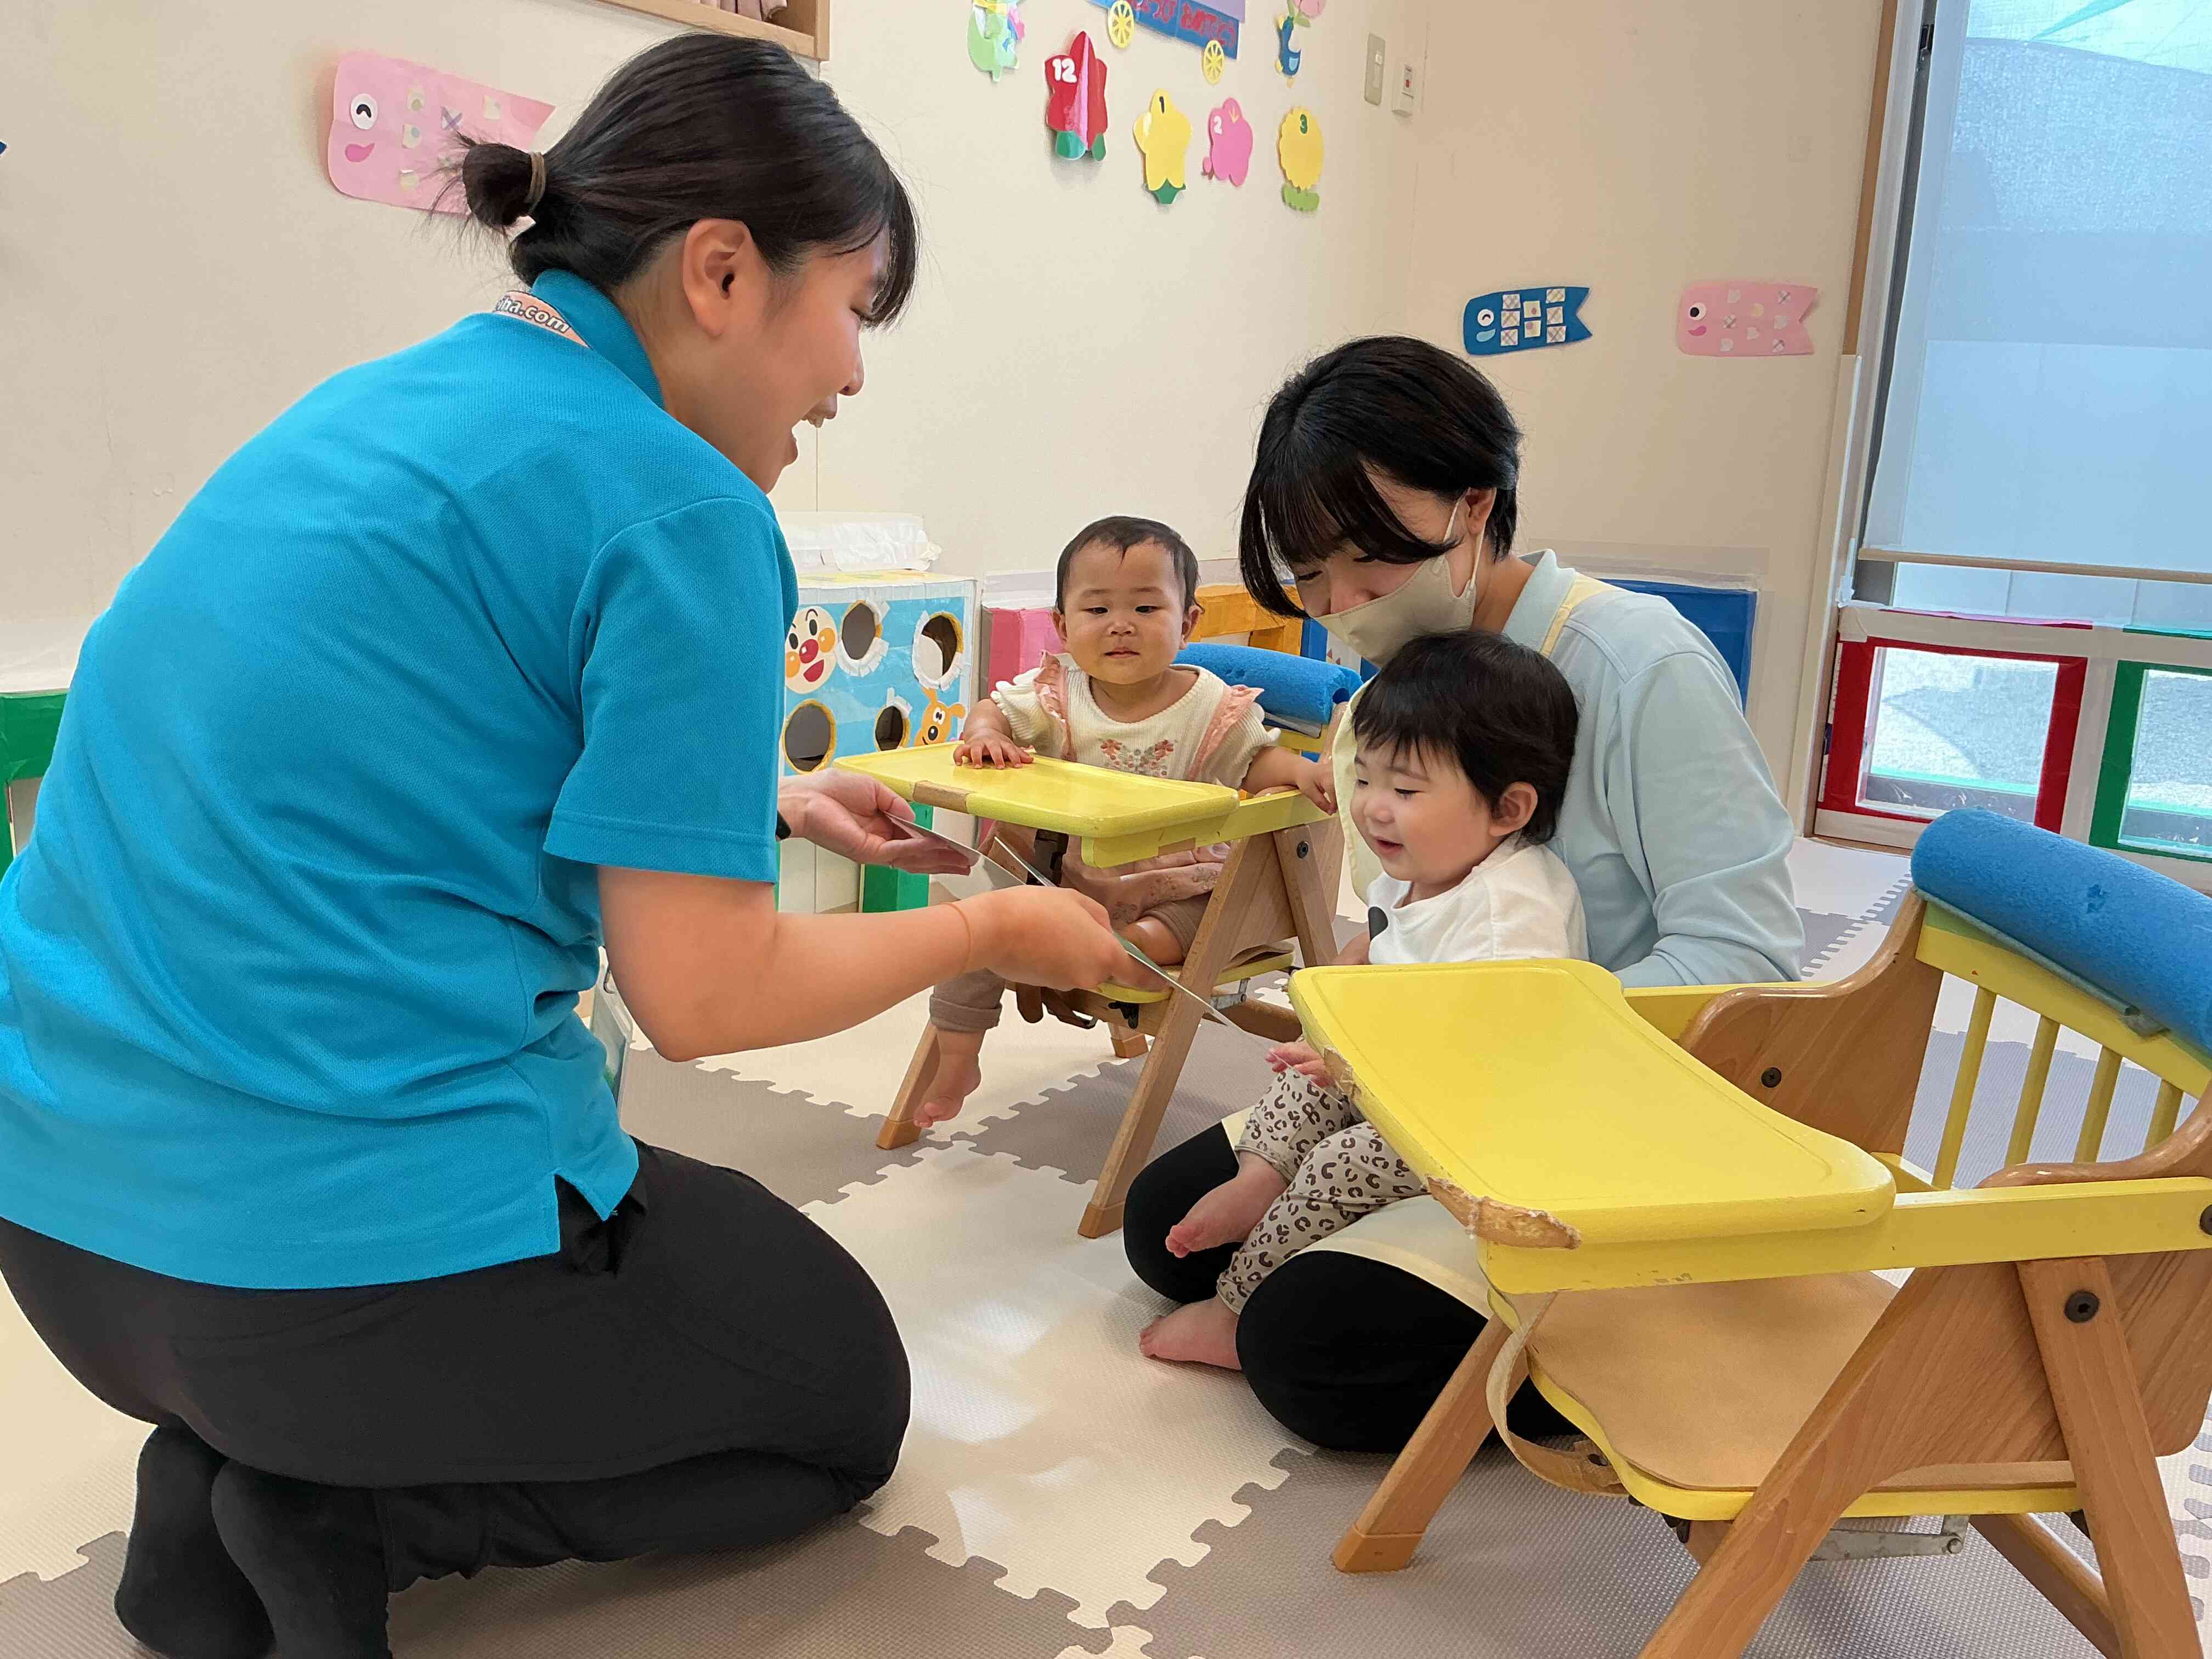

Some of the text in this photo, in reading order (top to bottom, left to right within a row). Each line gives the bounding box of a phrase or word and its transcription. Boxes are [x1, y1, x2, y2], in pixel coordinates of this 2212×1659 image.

[1052, 58, 1077, 83] 12
[1159, 96, 1165, 114] 1
[1213, 114, 1223, 135] 2
[1300, 114, 1308, 134] 3
